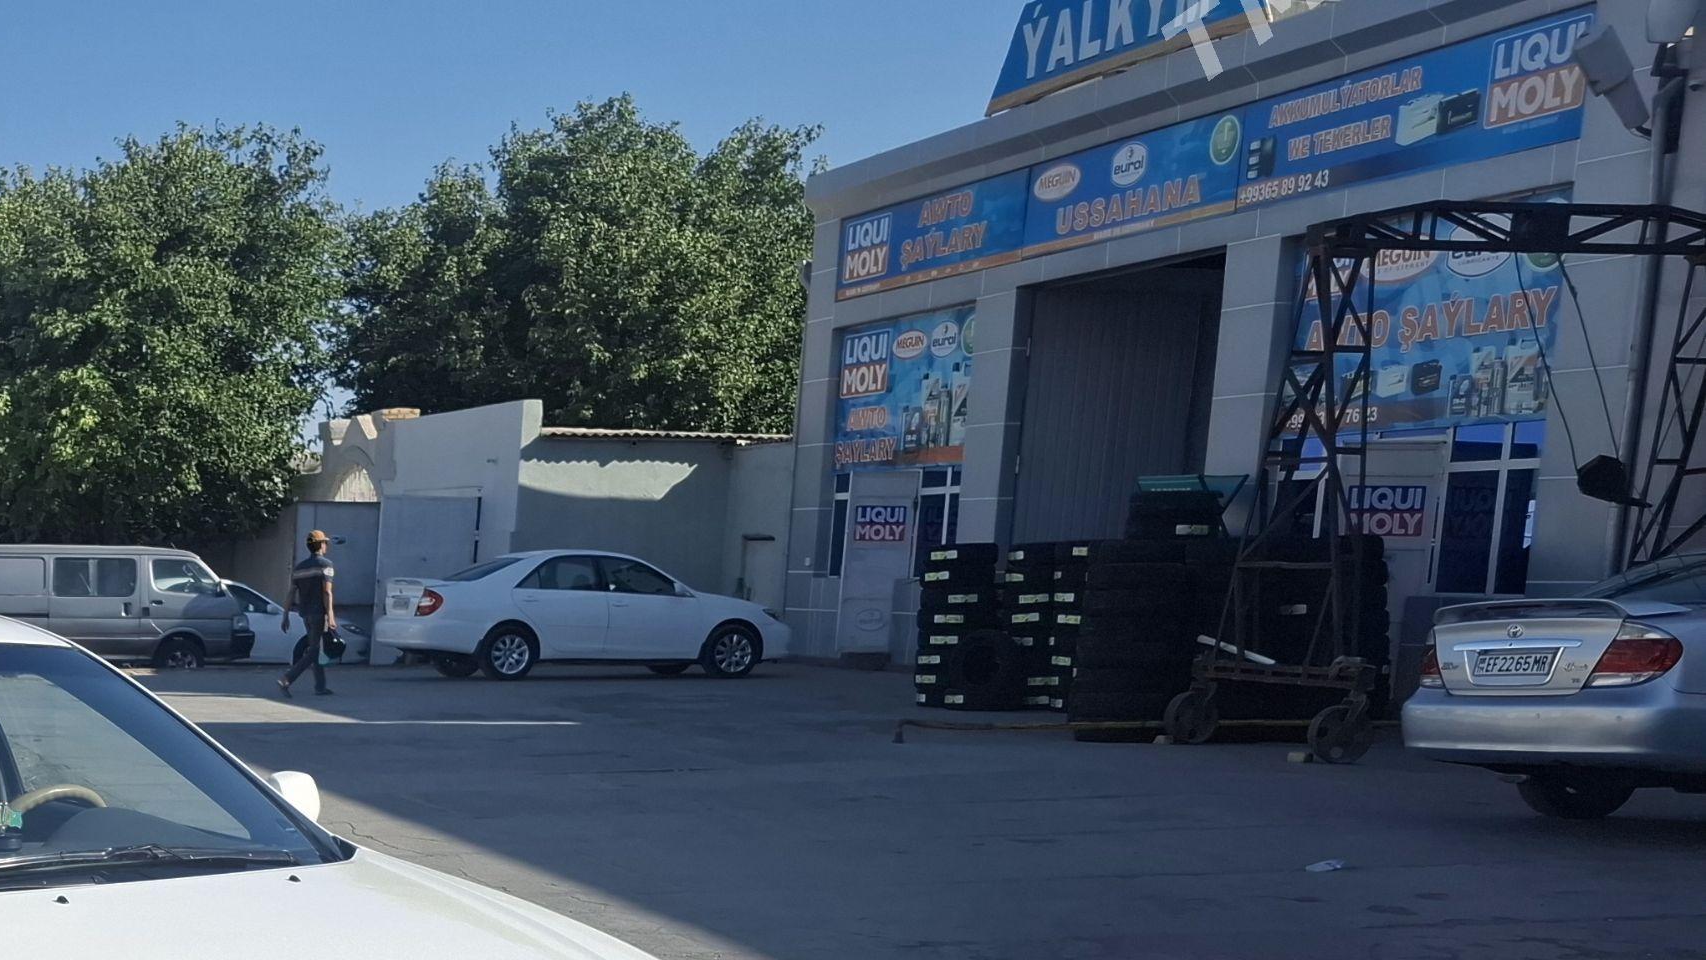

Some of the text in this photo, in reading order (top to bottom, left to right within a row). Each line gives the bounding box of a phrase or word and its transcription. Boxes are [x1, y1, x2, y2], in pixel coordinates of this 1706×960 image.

[1268, 66, 1423, 128] AKKUMULÝATORLAR
[1490, 66, 1580, 122] MOLY
[1288, 114, 1392, 161] WE TEKERLER
[1038, 168, 1077, 190] MEGUIN
[1113, 157, 1144, 175] eurol
[1240, 169, 1330, 204] +99365 89 92 43
[918, 190, 974, 228] AWTO
[1056, 174, 1201, 236] USSAHANA
[847, 217, 889, 250] LIQUI
[900, 220, 988, 272] ŞAÝLARY
[845, 246, 887, 280] MOLY
[1398, 286, 1558, 353] ŞAÝLARY
[846, 333, 888, 364] LIQUI
[896, 334, 925, 350] MEGUIN
[932, 333, 957, 347] eurol
[843, 363, 887, 395] MOLY
[846, 406, 887, 431] AWTO
[835, 434, 897, 469] ŞAÝLARY
[856, 505, 906, 523] LIQUI
[1350, 487, 1423, 511] LIQUI
[854, 524, 906, 541] MOLY
